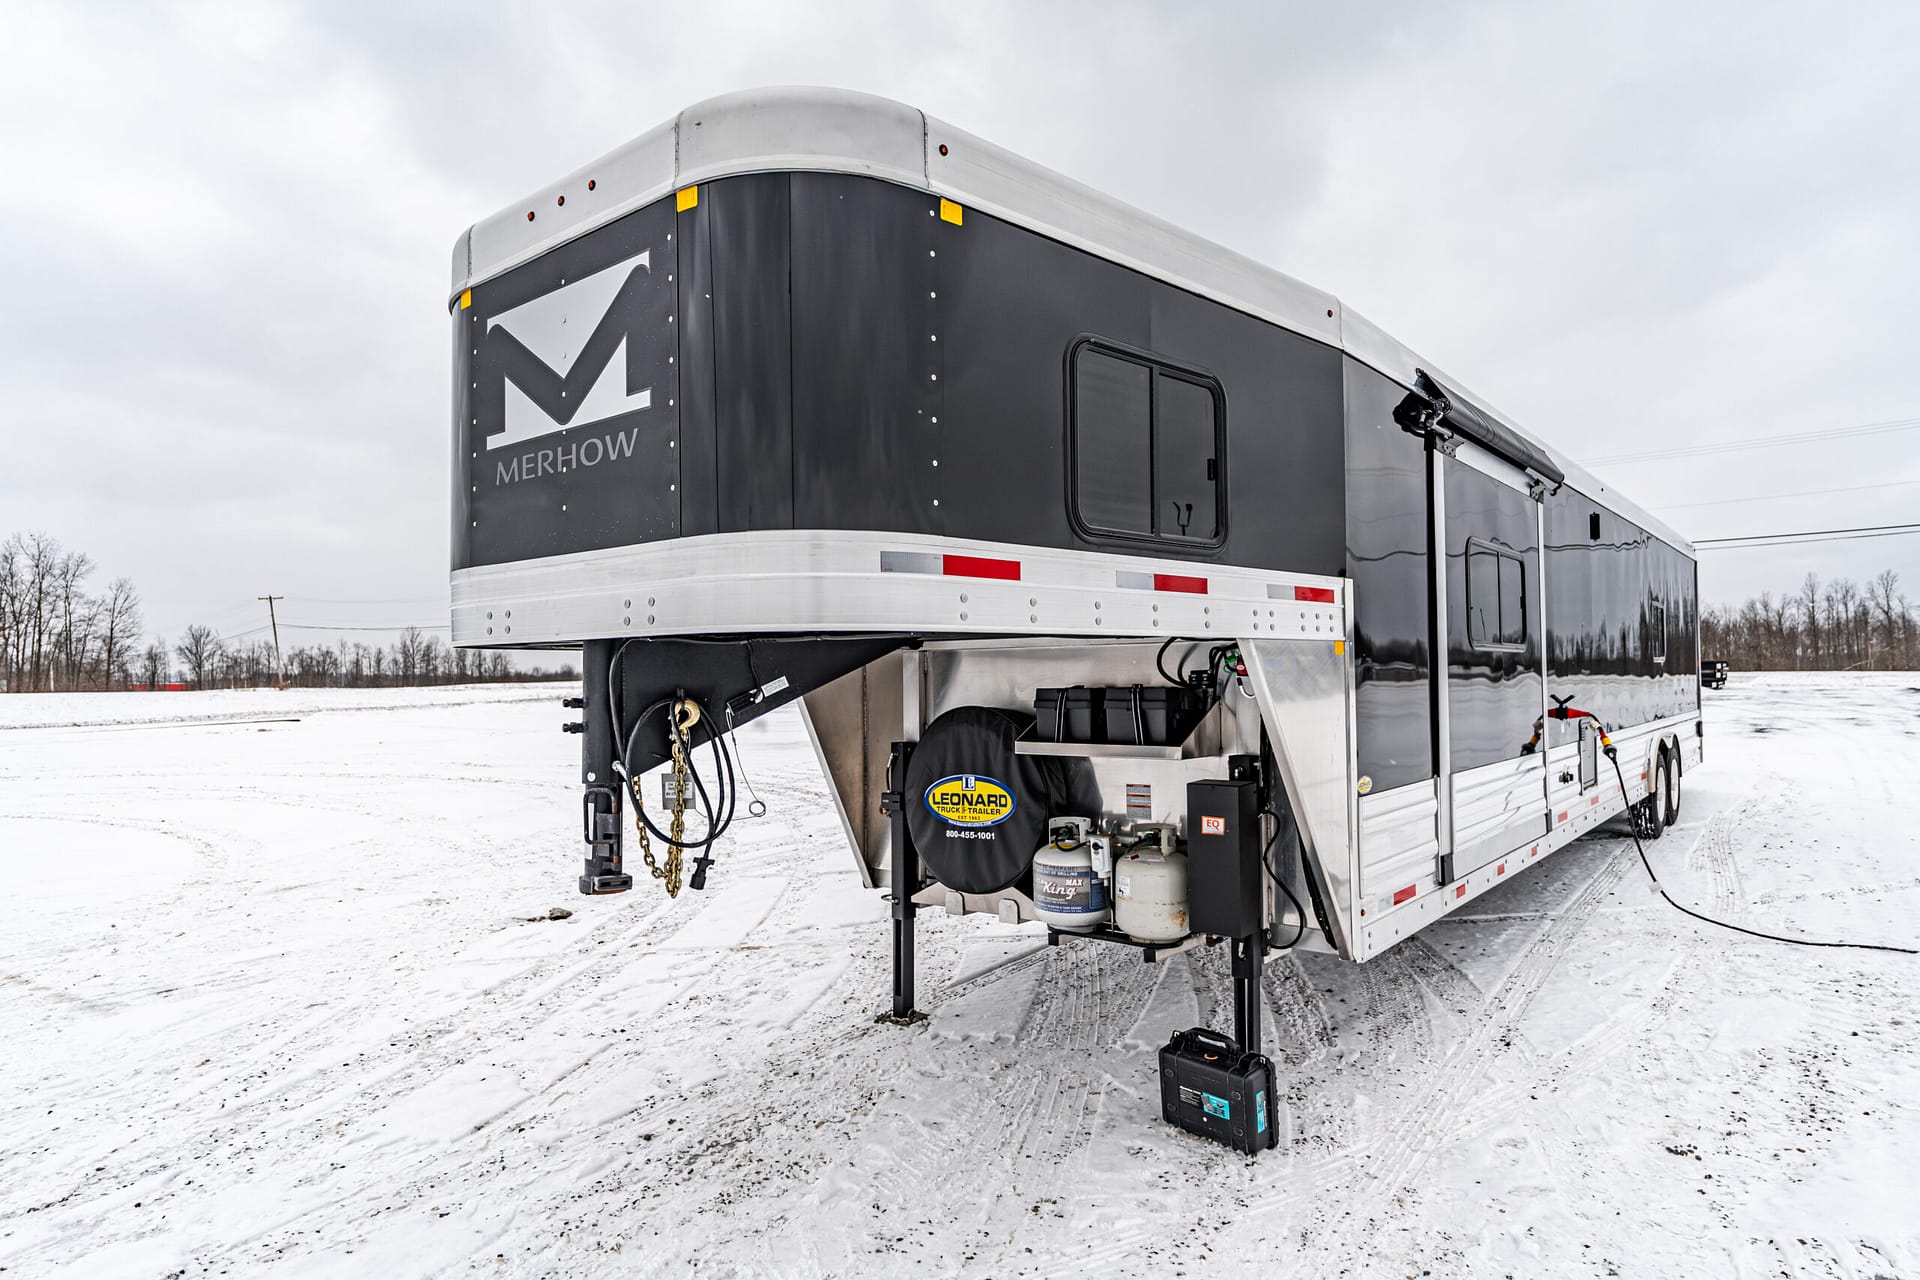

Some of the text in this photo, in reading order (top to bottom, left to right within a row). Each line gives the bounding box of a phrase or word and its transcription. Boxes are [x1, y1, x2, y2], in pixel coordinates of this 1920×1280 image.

[496, 428, 639, 486] MERHOW
[932, 792, 1008, 808] LEONARD
[937, 806, 961, 814] TRUCK
[967, 807, 1001, 815] TRAILER
[1206, 819, 1220, 831] EQ
[945, 830, 995, 840] 800-455-1001
[1065, 878, 1083, 886] MAX
[1041, 881, 1077, 900] King
